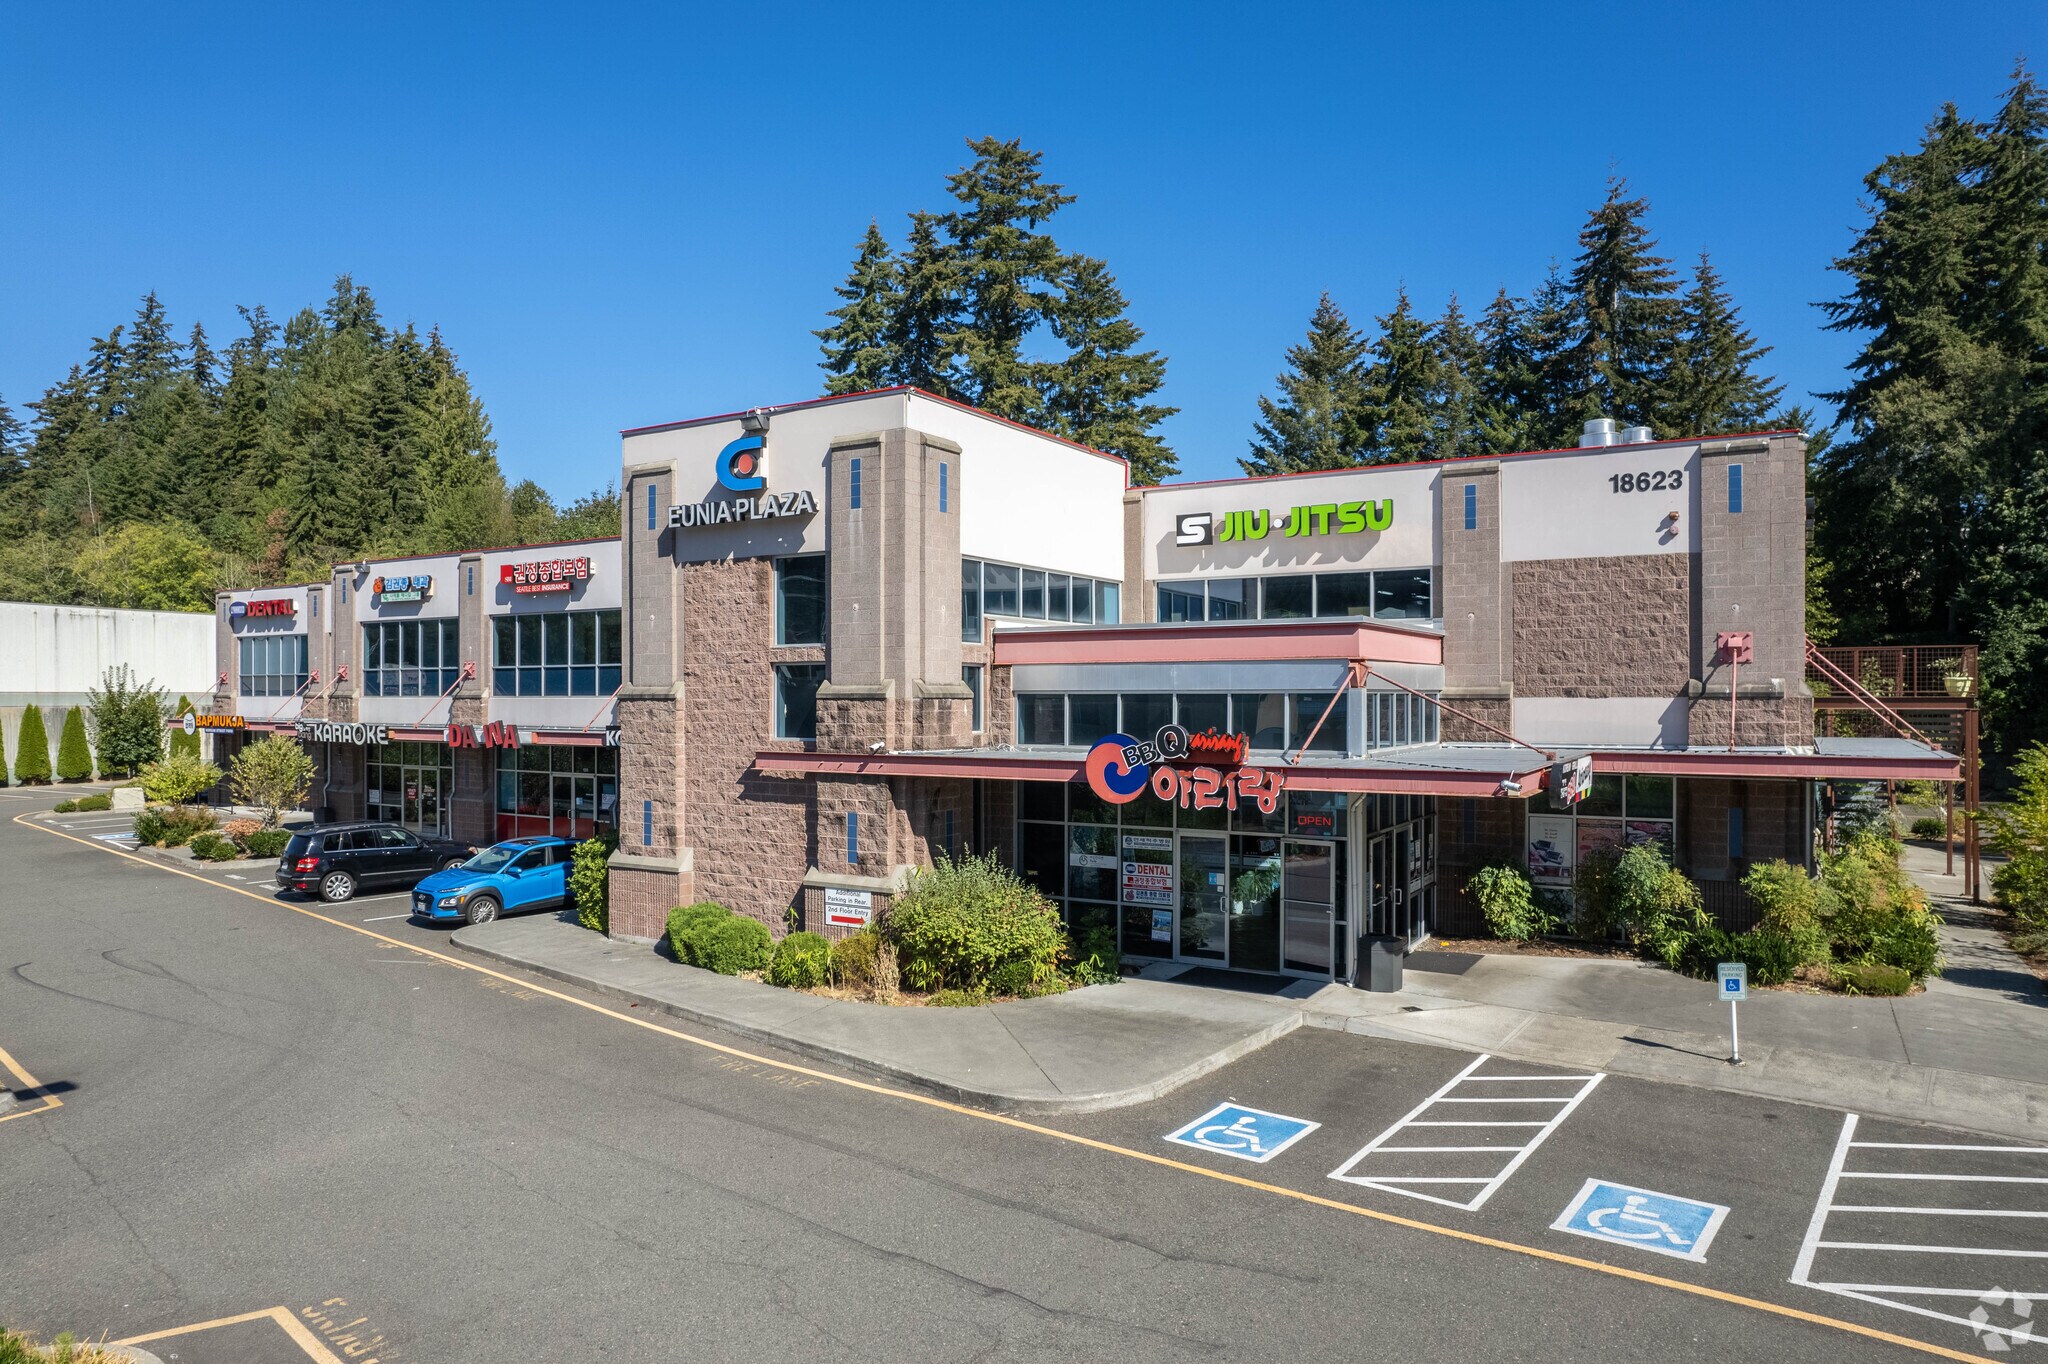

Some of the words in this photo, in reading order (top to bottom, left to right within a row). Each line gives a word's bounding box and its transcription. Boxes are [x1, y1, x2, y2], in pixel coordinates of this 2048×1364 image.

[1608, 469, 1683, 494] 18623
[667, 501, 732, 528] EUNIA
[735, 490, 814, 522] PLAZA
[542, 582, 570, 591] INSURANCE
[247, 599, 296, 617] DENTAL
[196, 715, 244, 728] BAPMUKJA
[306, 723, 389, 746] KARAOKE
[1121, 724, 1189, 769] BBQ
[1153, 766, 1284, 814] 아리랑
[1297, 815, 1331, 826] OPEN
[1137, 864, 1171, 876] DENTAL
[854, 909, 868, 917] Entry
